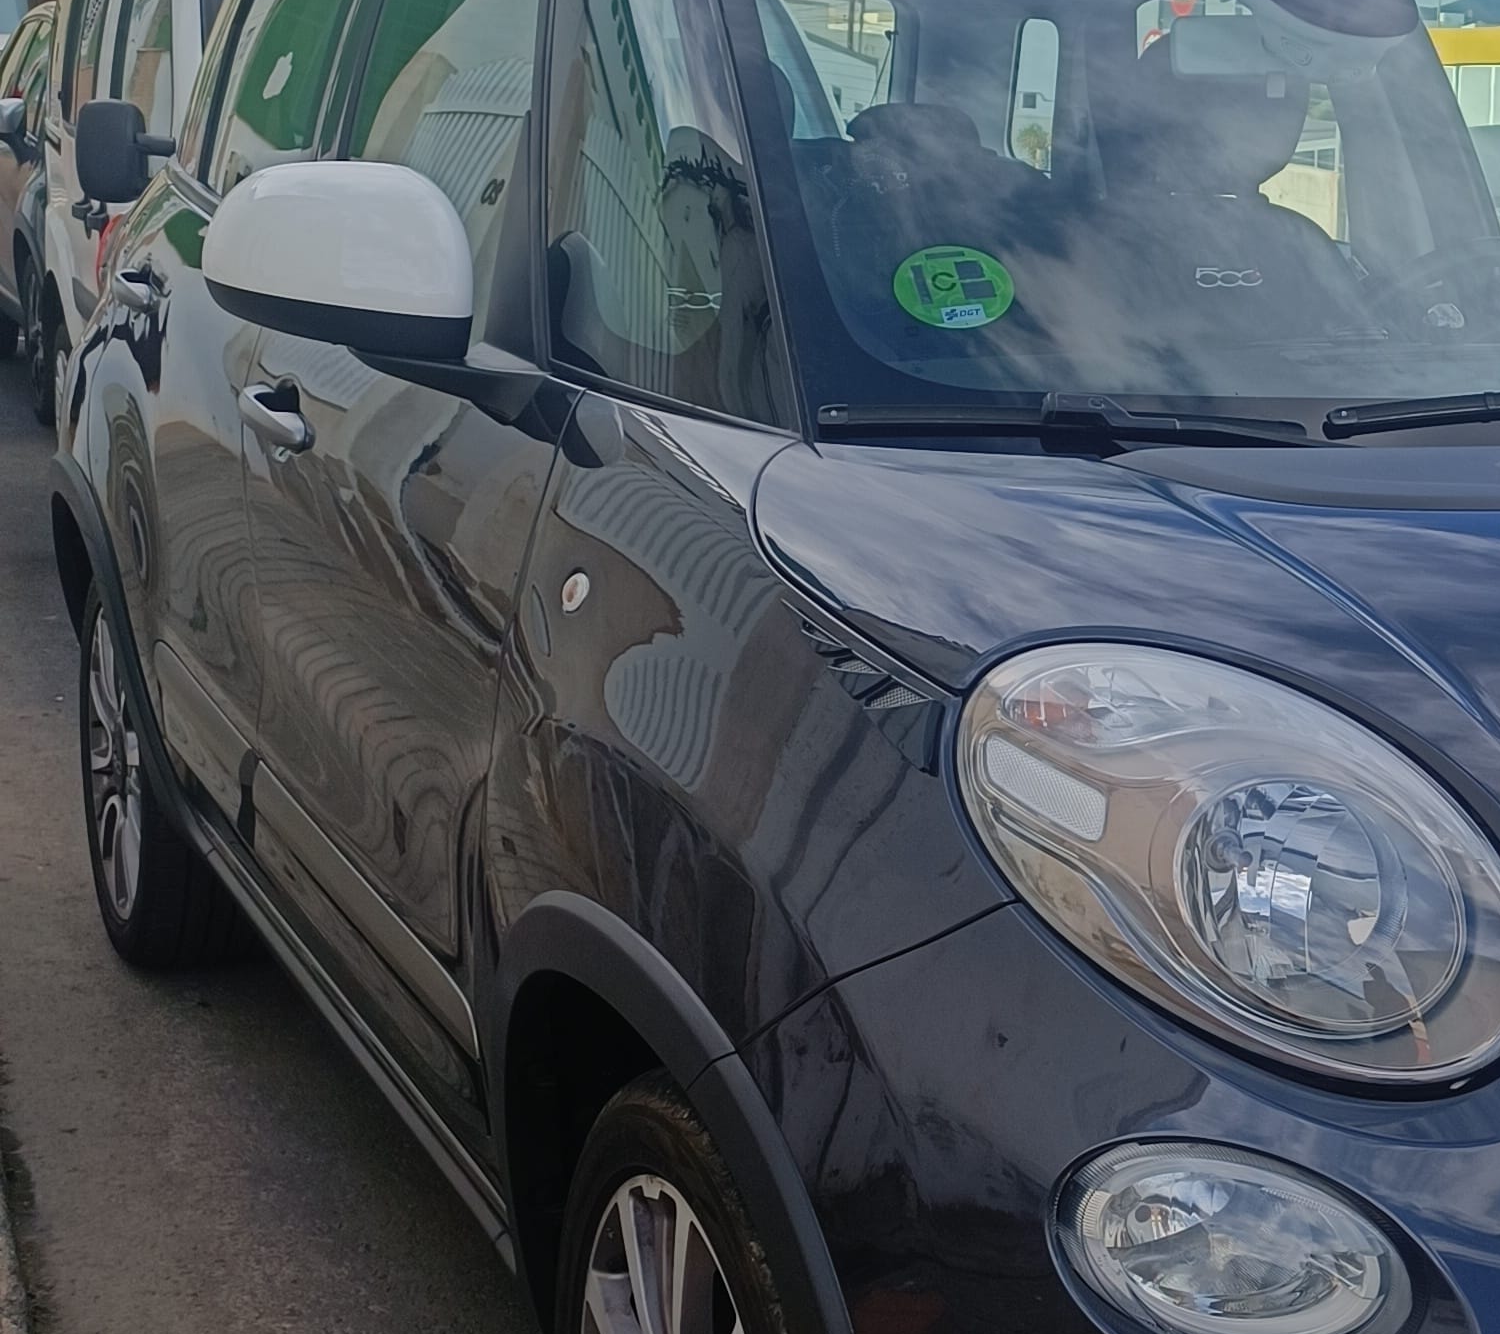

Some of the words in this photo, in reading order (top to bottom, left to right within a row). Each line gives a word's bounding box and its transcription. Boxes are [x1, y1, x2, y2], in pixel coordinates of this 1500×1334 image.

[931, 272, 957, 292] C
[1195, 267, 1263, 288] 500
[959, 308, 981, 318] DGT
